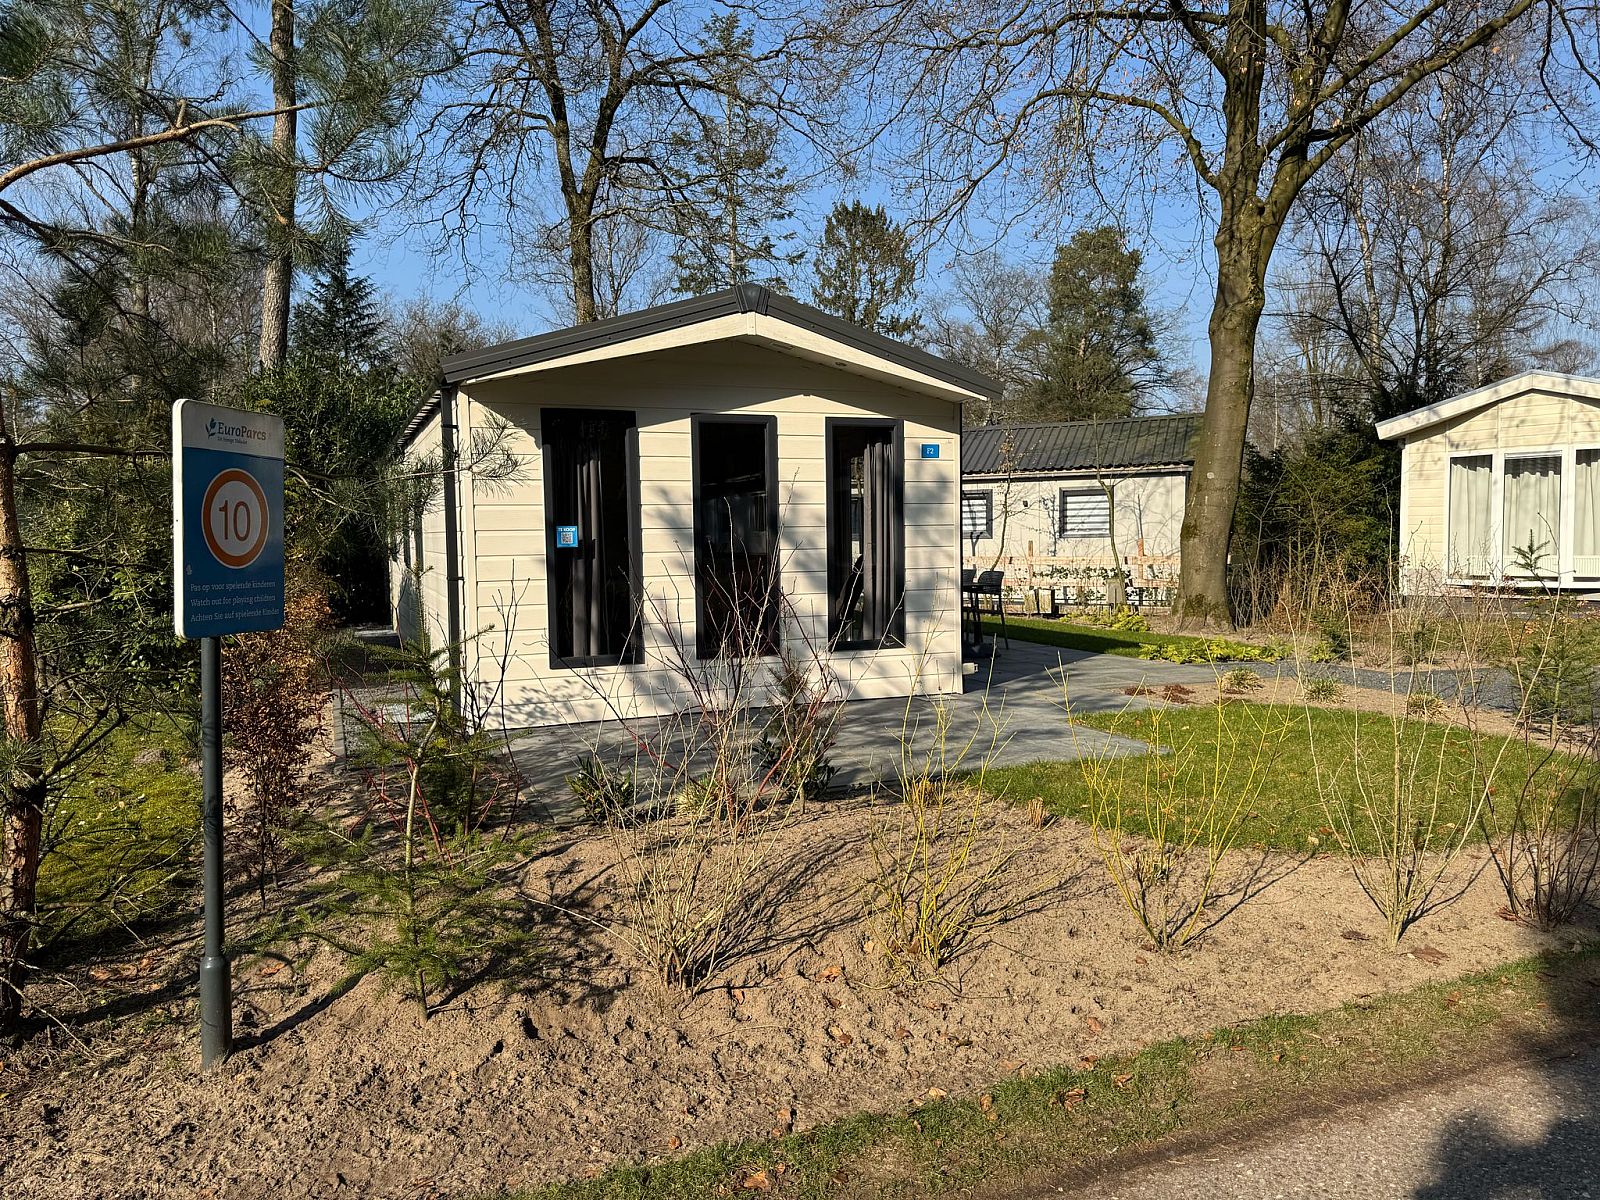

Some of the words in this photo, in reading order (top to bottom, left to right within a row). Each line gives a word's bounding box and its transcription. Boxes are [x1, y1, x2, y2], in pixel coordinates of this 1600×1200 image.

[217, 421, 267, 441] EuroParcs
[219, 500, 250, 541] 10
[190, 583, 201, 592] Pas
[202, 584, 211, 592] op
[225, 580, 252, 591] spelende
[252, 580, 276, 588] kinderen
[190, 597, 211, 607] Watch
[222, 597, 232, 605] for
[232, 595, 253, 606] playing
[253, 594, 276, 602] children
[190, 613, 213, 623] Achten
[213, 612, 224, 620] Sie
[224, 610, 235, 619] auf
[235, 608, 262, 620] spielende
[262, 607, 280, 616] Kinder
